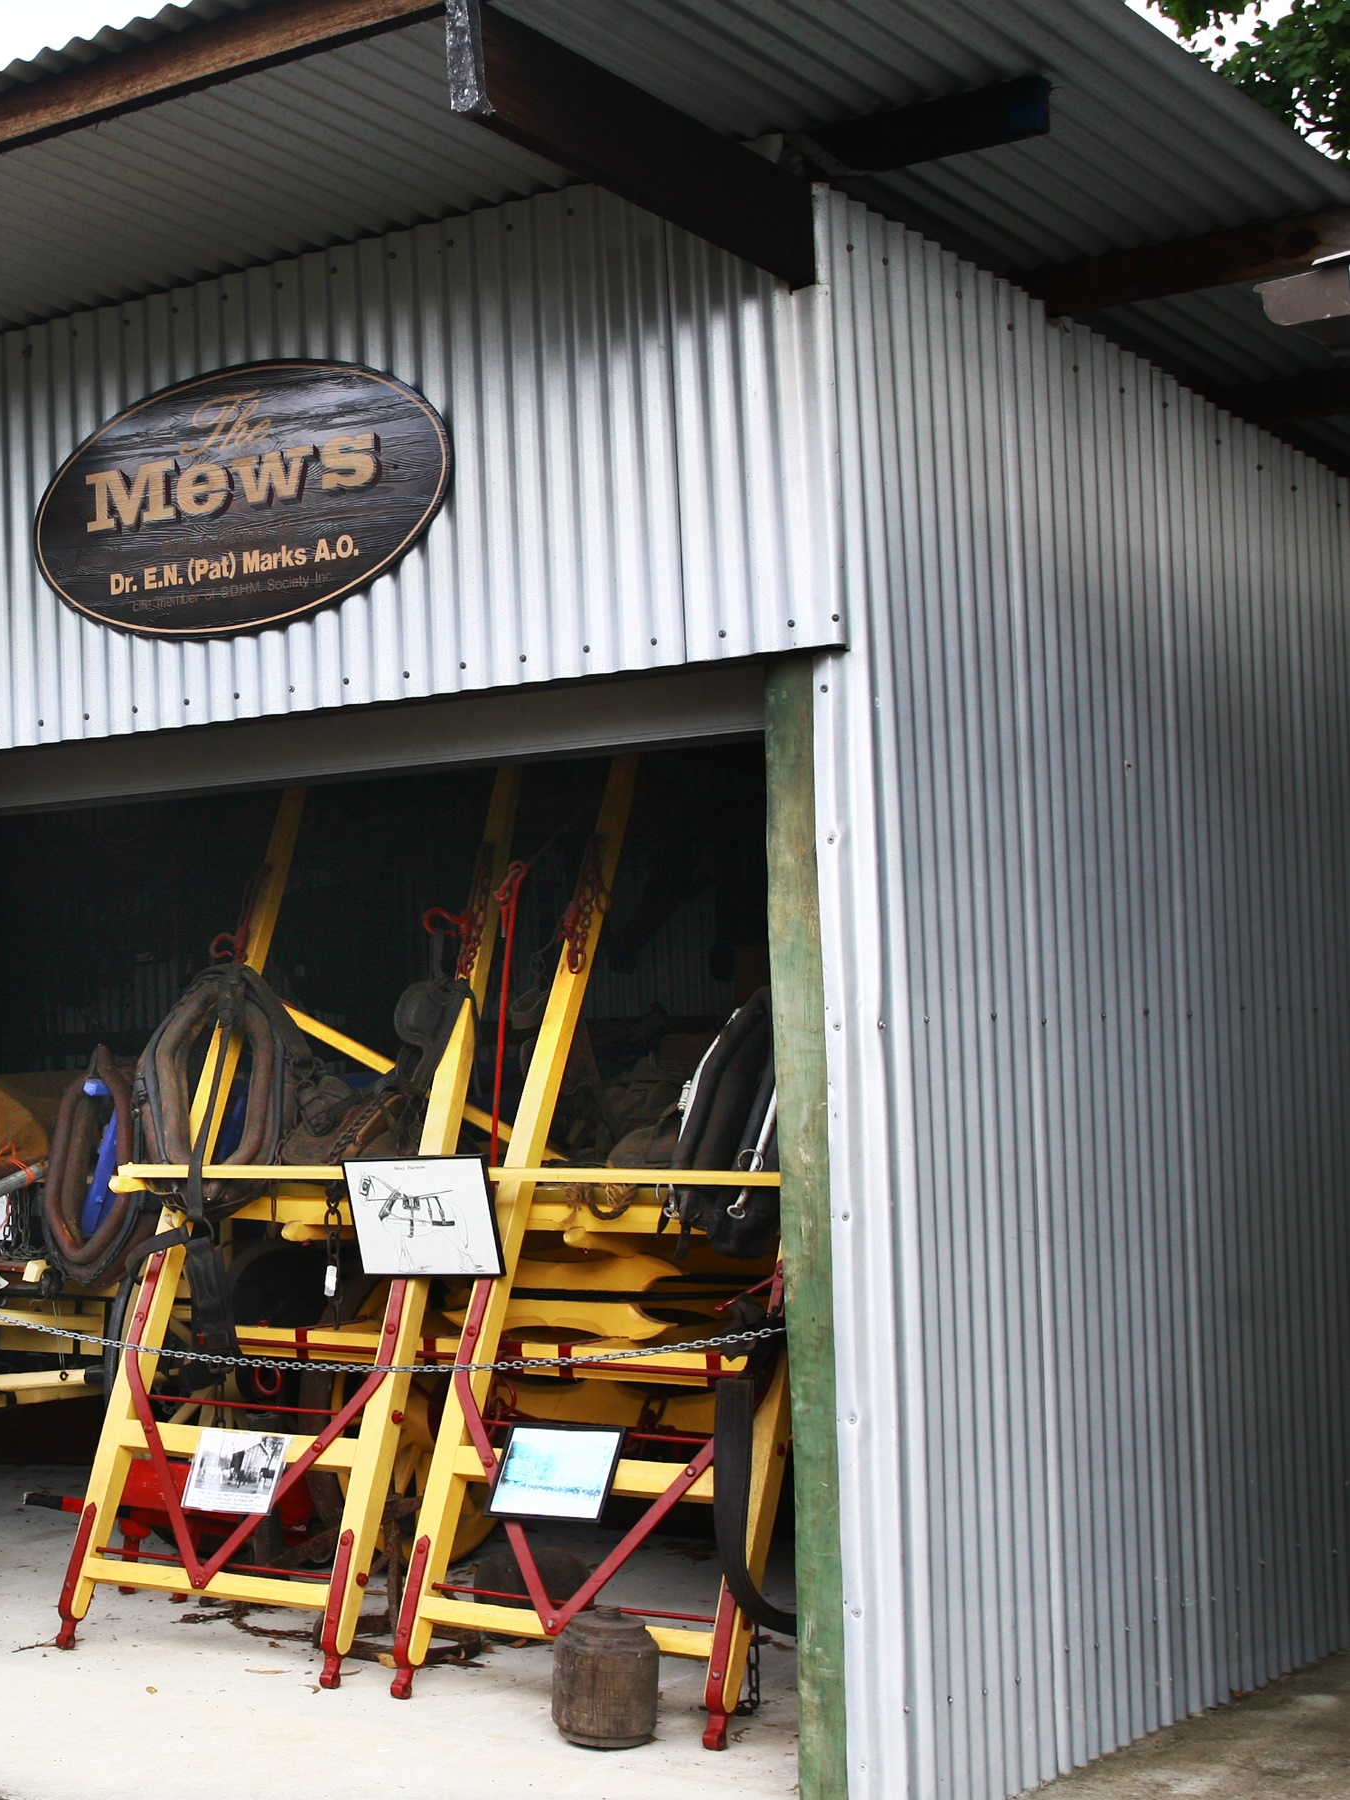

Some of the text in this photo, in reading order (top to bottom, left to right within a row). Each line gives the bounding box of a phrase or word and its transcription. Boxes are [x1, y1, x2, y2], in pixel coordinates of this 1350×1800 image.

[180, 389, 272, 456] The
[86, 432, 381, 534] Mews
[110, 534, 359, 596] Dr. E.N. (Pat) Marks A.O.
[156, 592, 199, 610] member
[204, 588, 217, 600] of
[267, 574, 310, 592] Society
[315, 570, 335, 583] Inc.
